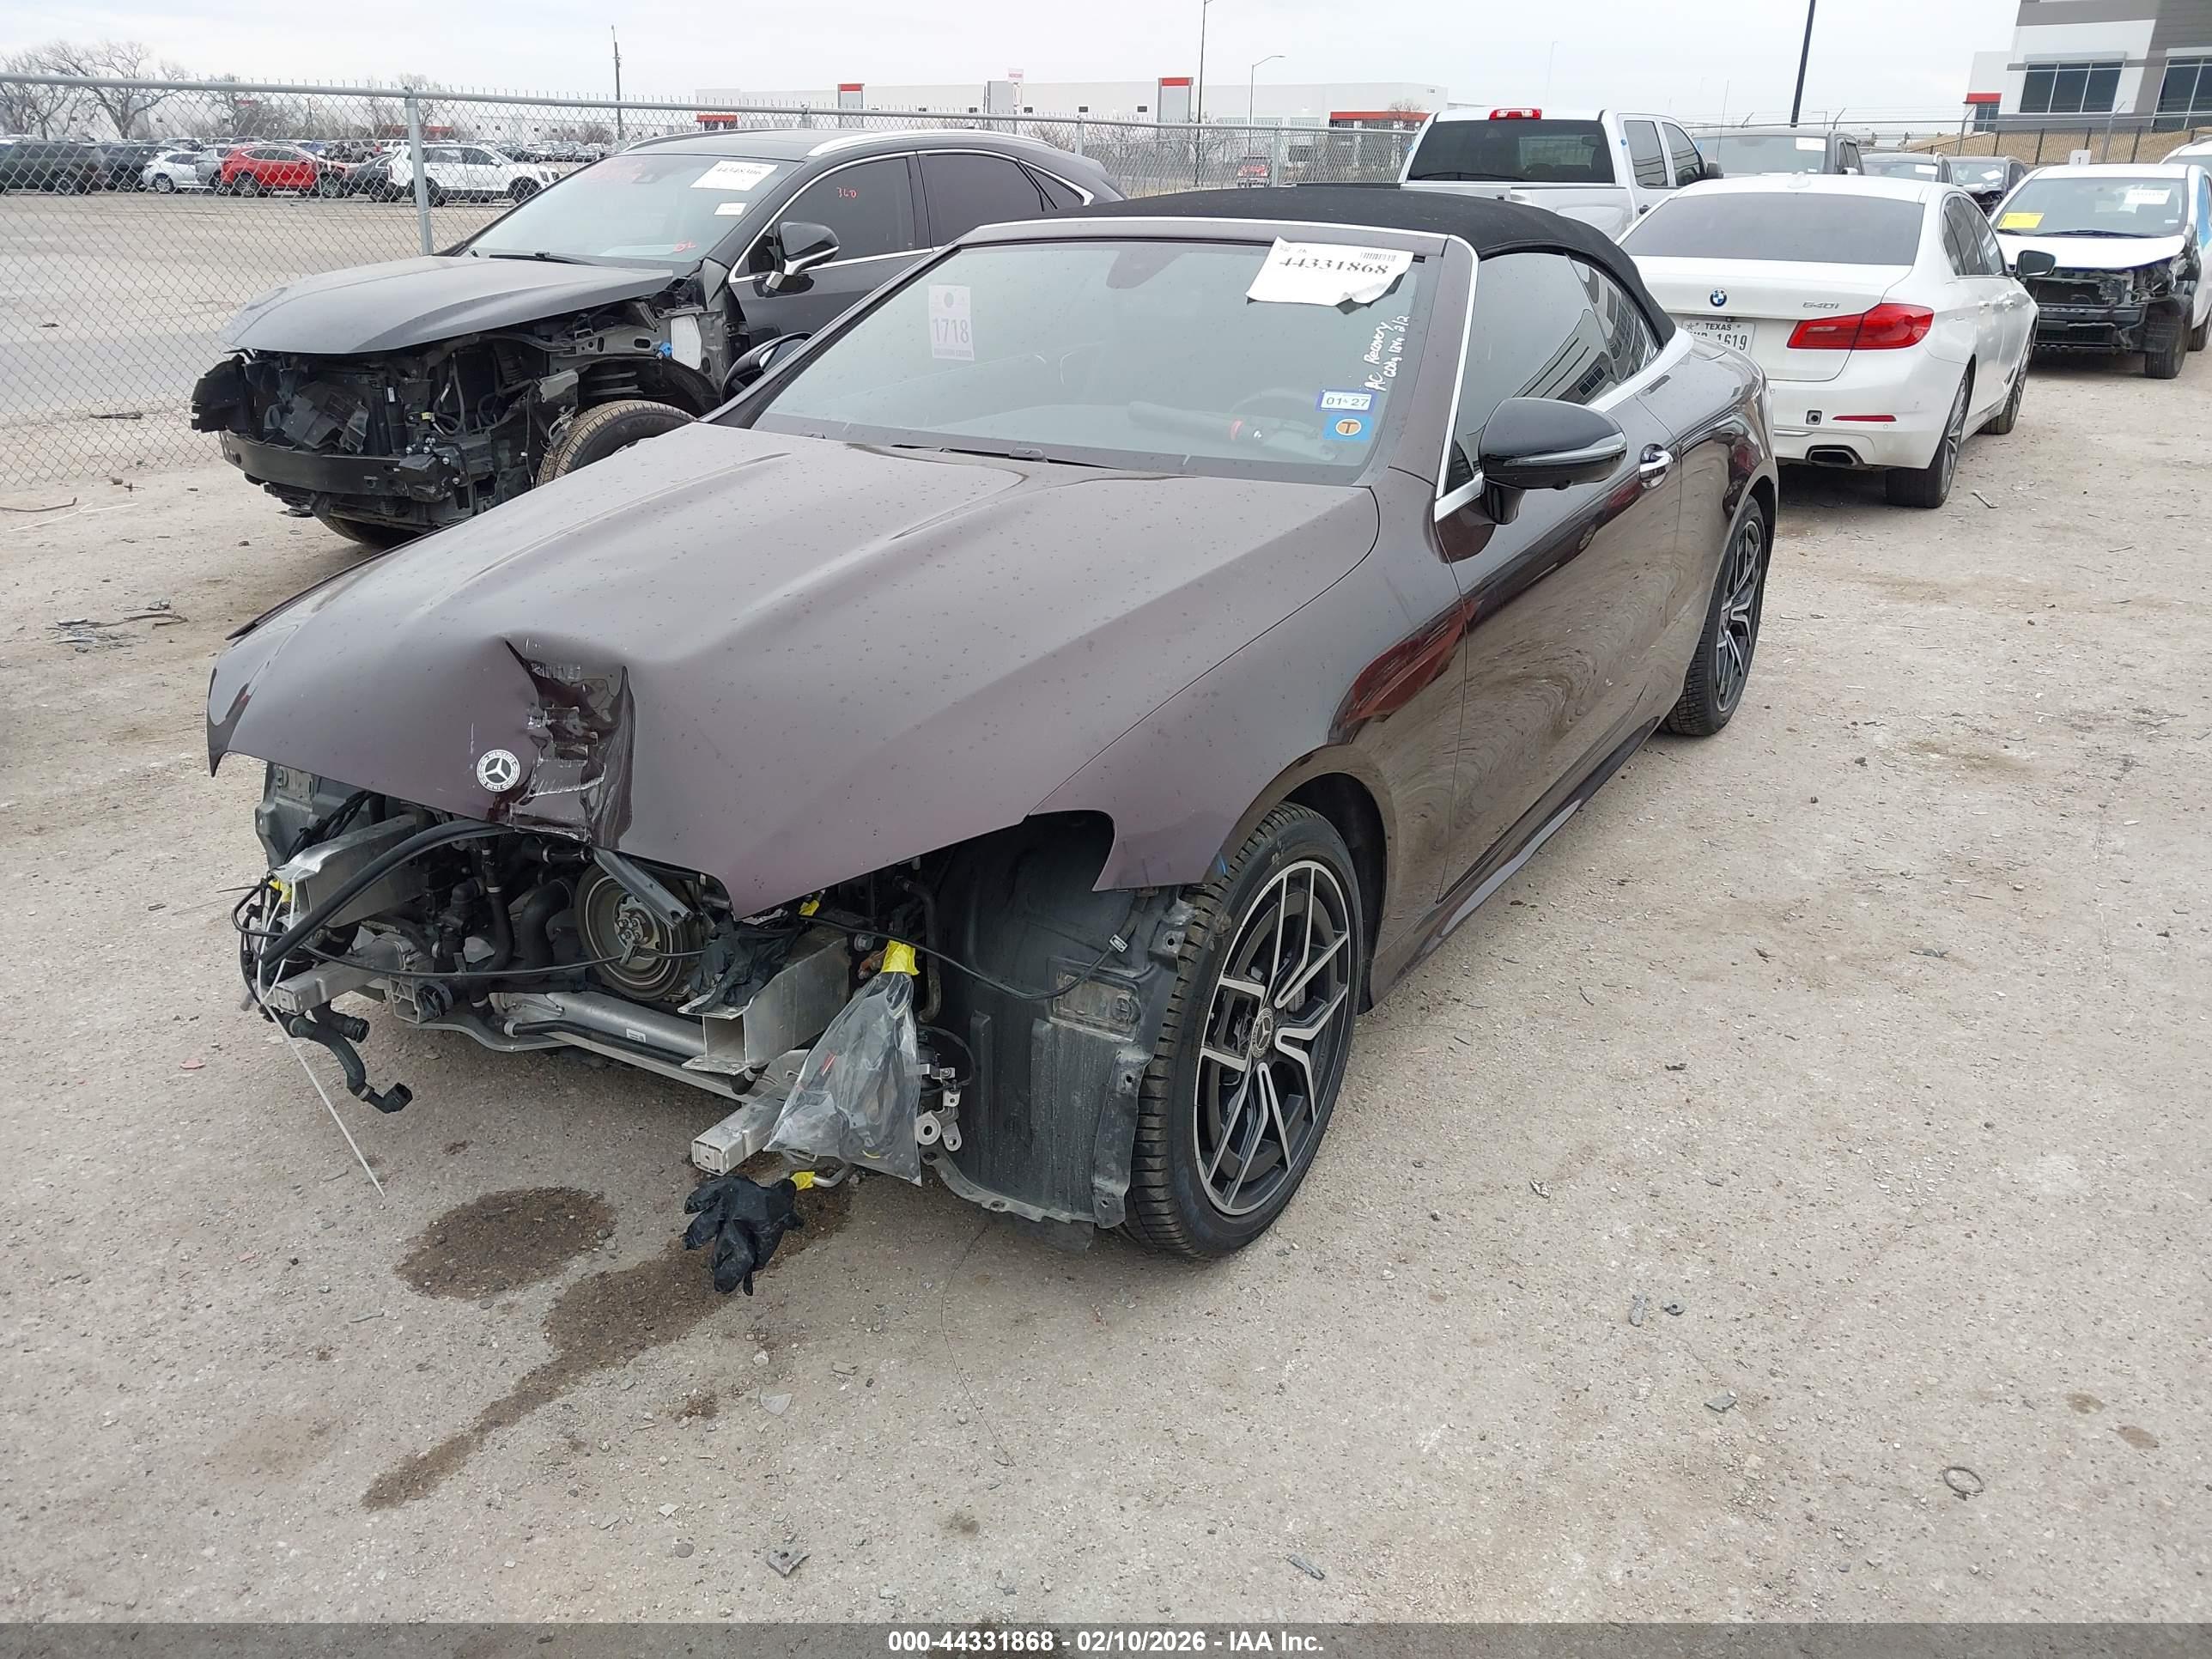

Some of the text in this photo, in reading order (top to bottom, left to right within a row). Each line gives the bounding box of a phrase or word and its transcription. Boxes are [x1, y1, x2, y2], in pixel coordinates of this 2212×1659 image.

[1279, 257, 1389, 275] 44331868
[933, 318, 969, 343] 1718
[1705, 323, 1732, 331] TEXAS
[1364, 322, 1395, 392] AC Recovery
[1326, 397, 1369, 407] 01 27
[1340, 421, 1358, 434] T
